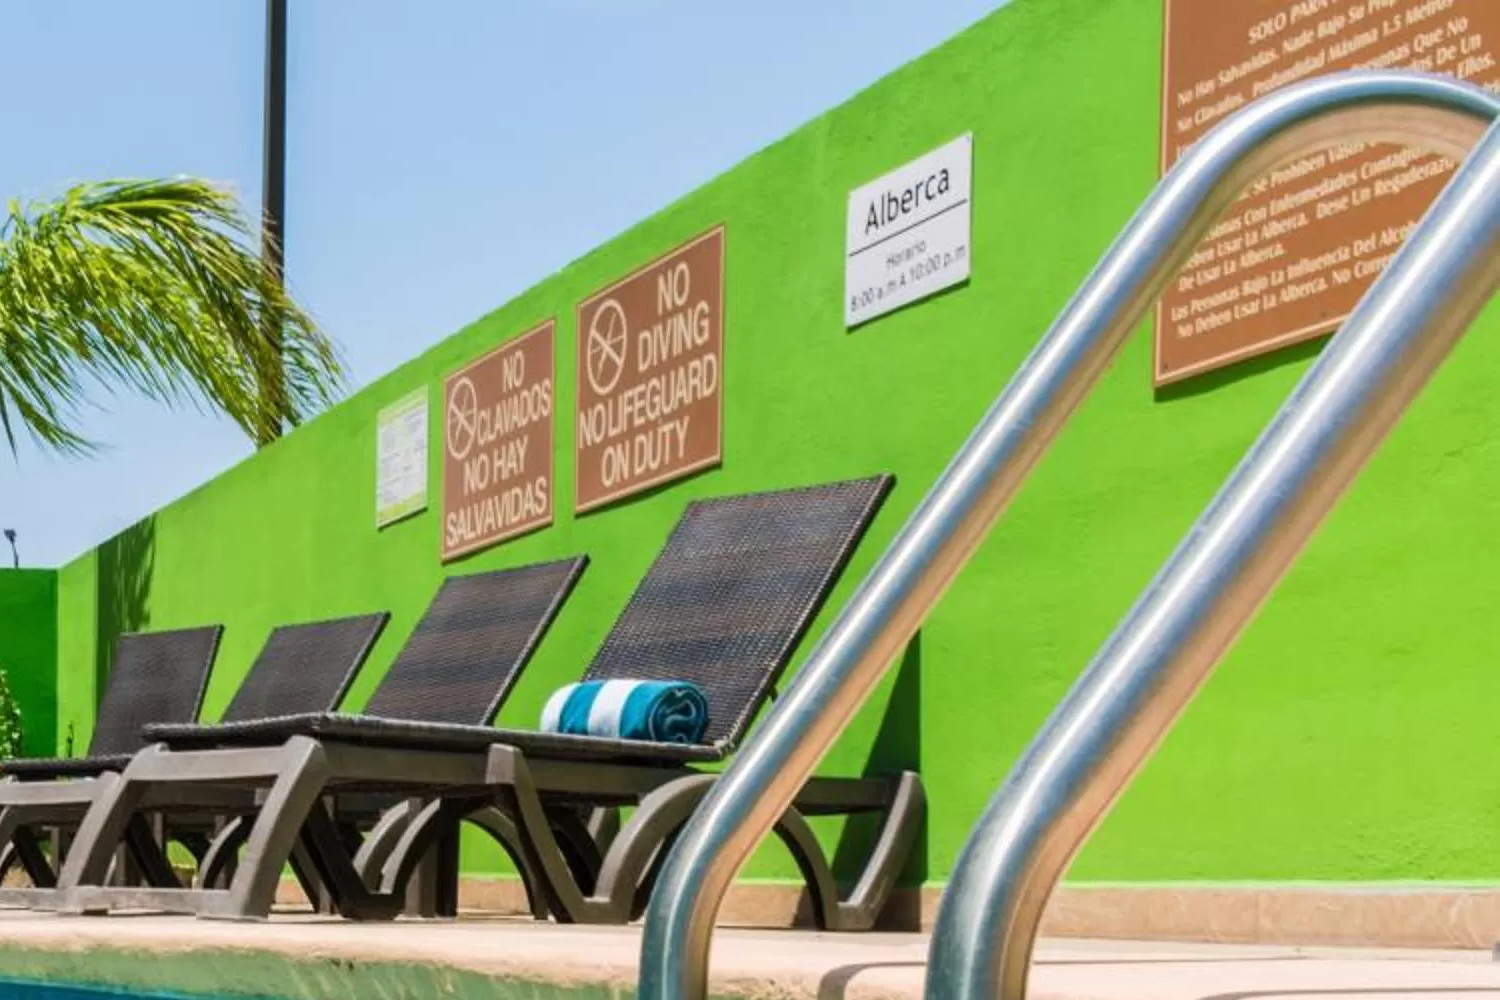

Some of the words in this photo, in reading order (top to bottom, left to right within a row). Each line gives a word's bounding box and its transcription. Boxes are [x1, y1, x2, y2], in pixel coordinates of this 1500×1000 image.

[1413, 28, 1444, 54] Que
[1447, 16, 1469, 37] No
[1436, 45, 1458, 65] De
[1460, 34, 1482, 55] Un
[864, 167, 949, 235] Alberca
[1353, 231, 1377, 257] Del
[657, 261, 691, 317] NO
[1331, 267, 1351, 288] No
[637, 299, 710, 374] DIVING
[503, 350, 525, 392] NO
[579, 402, 608, 449] NO
[607, 353, 718, 438] LIFEGUARD
[477, 377, 551, 446] CLAVADOS
[464, 452, 489, 497] NO
[493, 433, 529, 484] HAY
[601, 440, 630, 488] ON
[633, 415, 691, 476] DUTY
[446, 475, 548, 547] SALVAVIDAS
